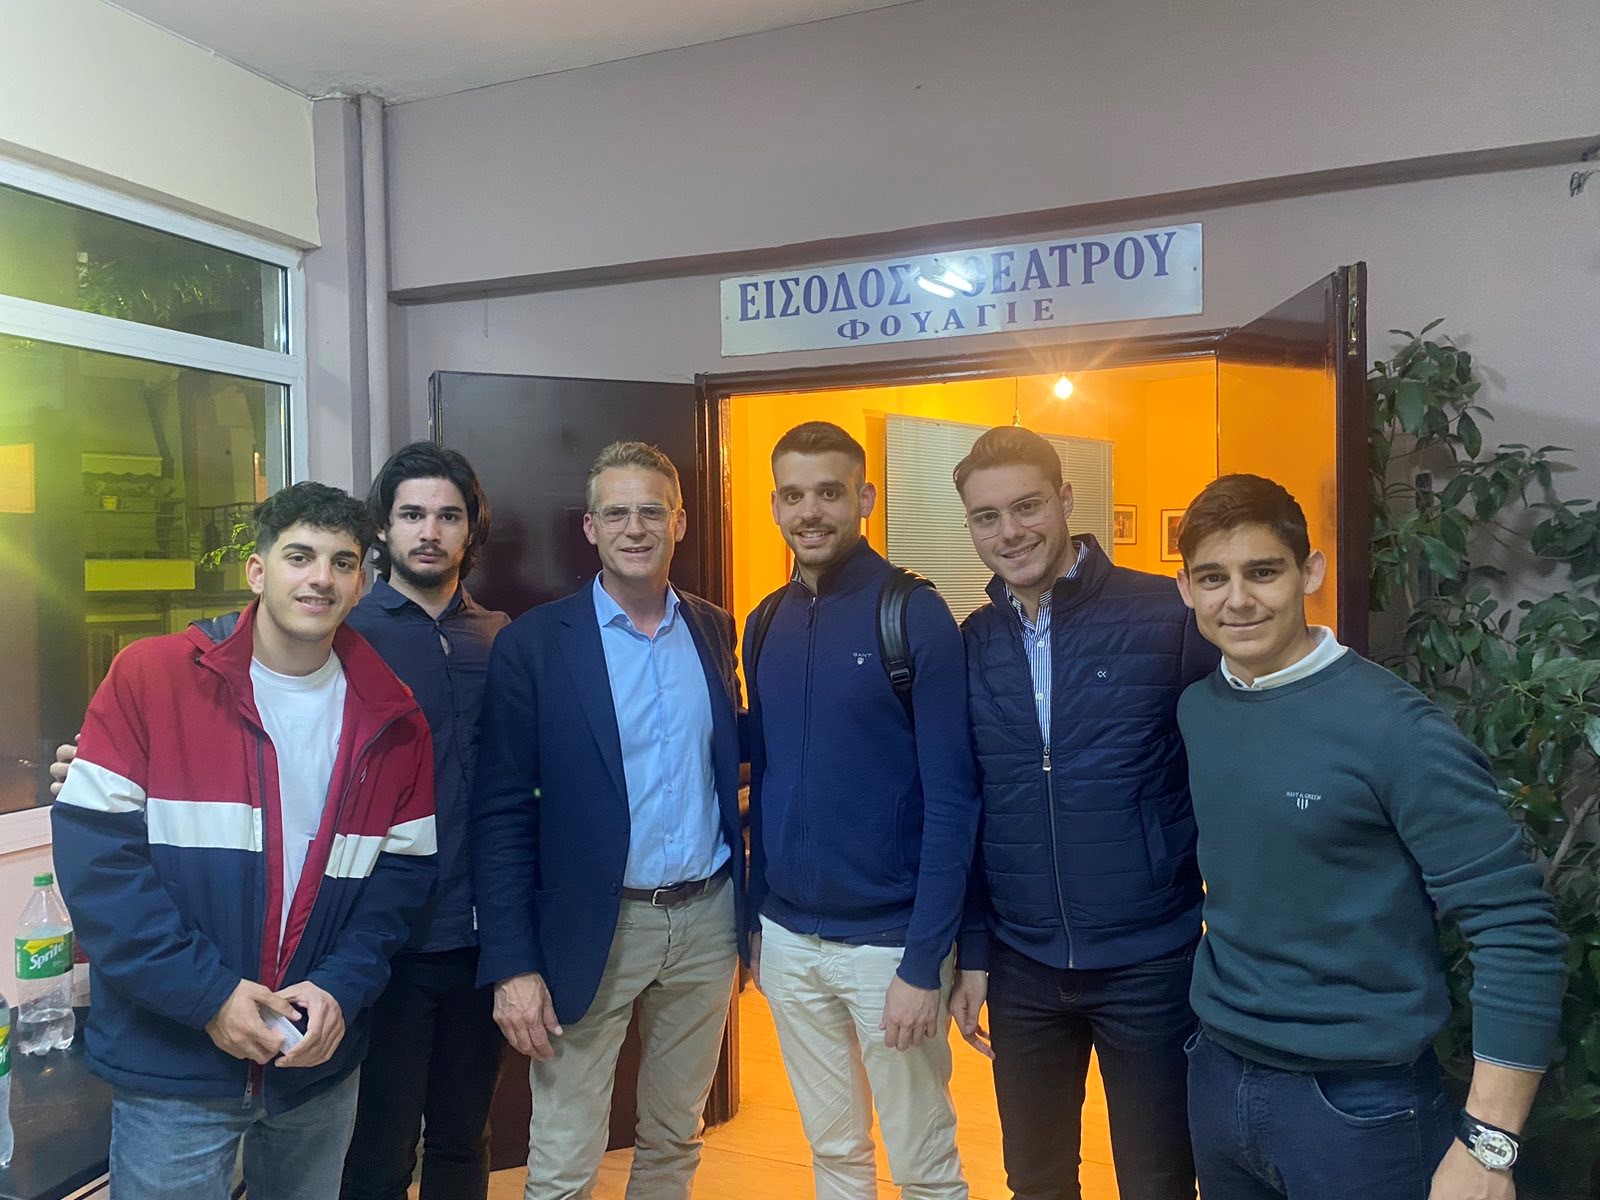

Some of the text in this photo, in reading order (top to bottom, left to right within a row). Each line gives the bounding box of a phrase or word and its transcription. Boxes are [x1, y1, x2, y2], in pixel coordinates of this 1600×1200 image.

[739, 264, 911, 321] ΕΙΣΟΔΟΣ
[837, 298, 1054, 340] ΦΟΥΑΓΙΕ
[29, 943, 64, 970] Sprite
